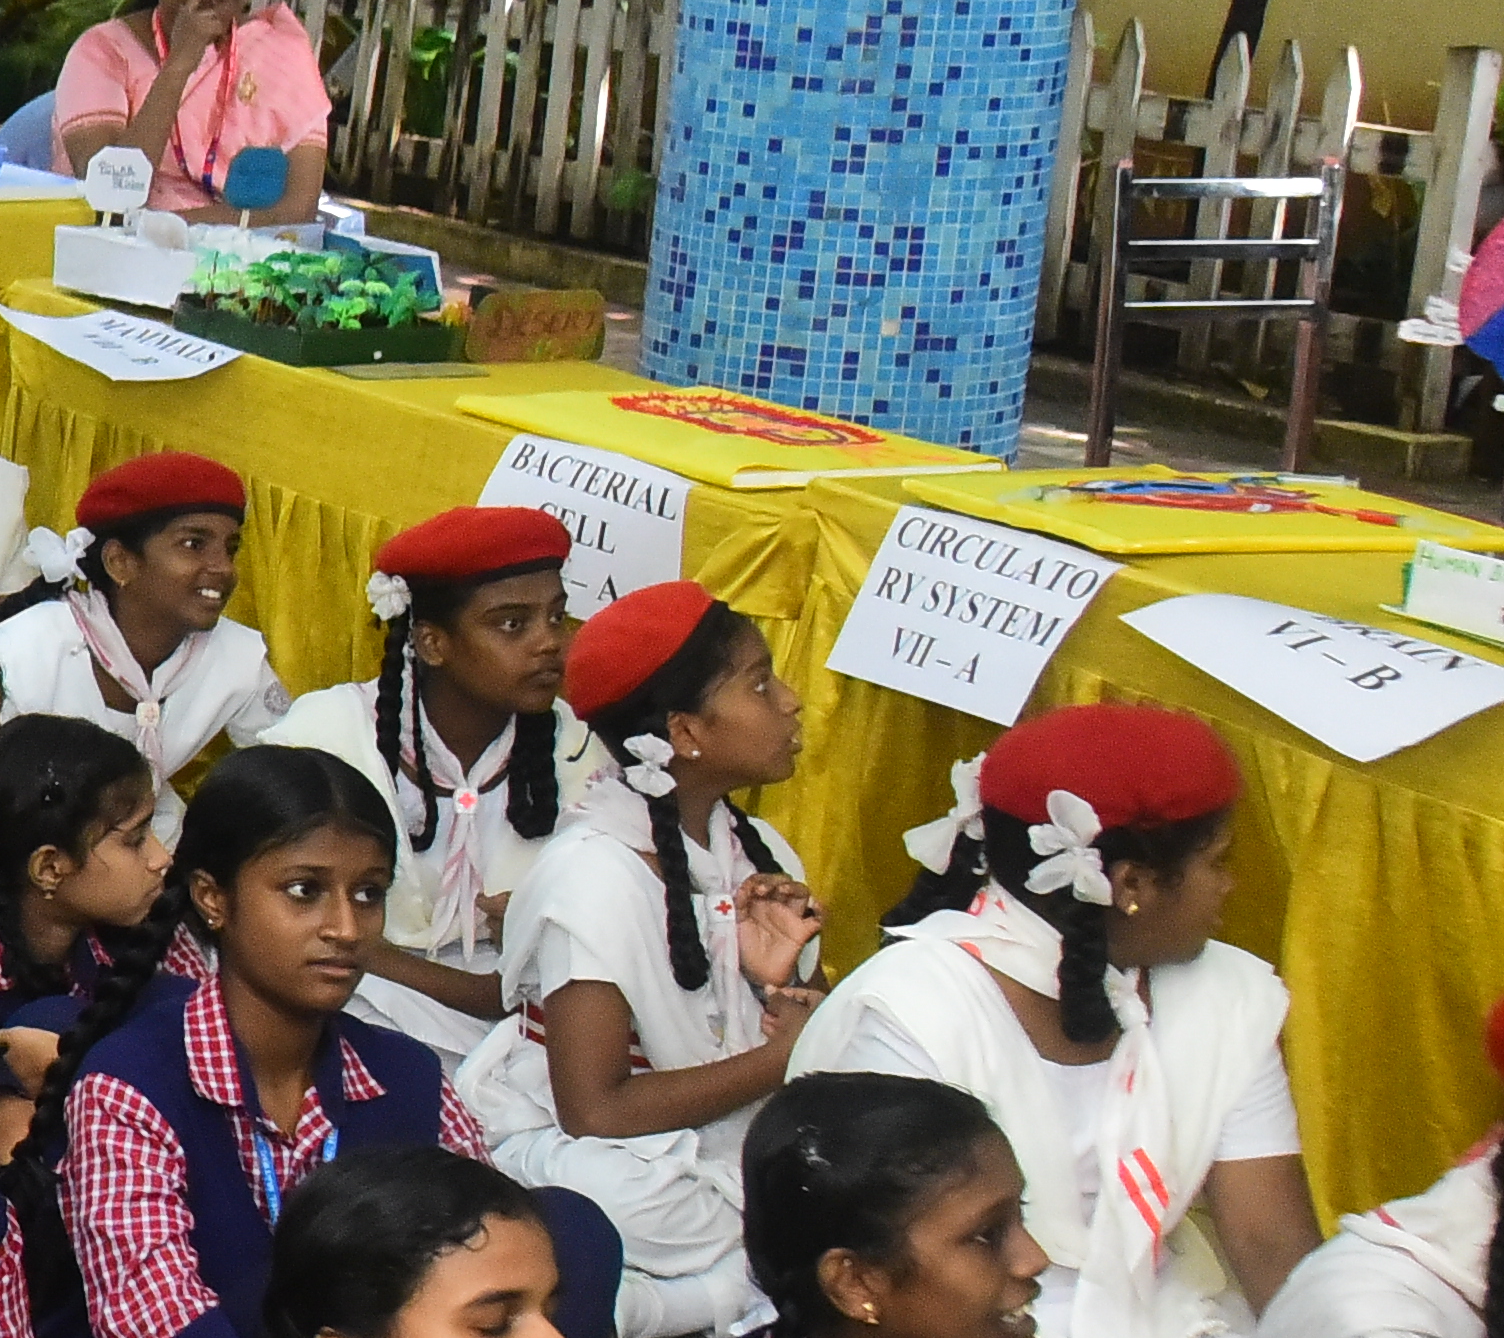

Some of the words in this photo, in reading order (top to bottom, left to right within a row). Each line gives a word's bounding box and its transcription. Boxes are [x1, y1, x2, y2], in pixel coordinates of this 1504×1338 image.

[100, 318, 223, 363] MAMMALS
[510, 442, 677, 521] BACTERIAL
[598, 574, 619, 603] A
[897, 516, 1100, 600] CIRCULATO
[874, 566, 926, 605] RY
[922, 580, 1063, 648] SYSTEM
[891, 627, 937, 669] VII
[954, 652, 982, 685] A
[1266, 619, 1333, 651] VI
[1348, 663, 1403, 691] B
